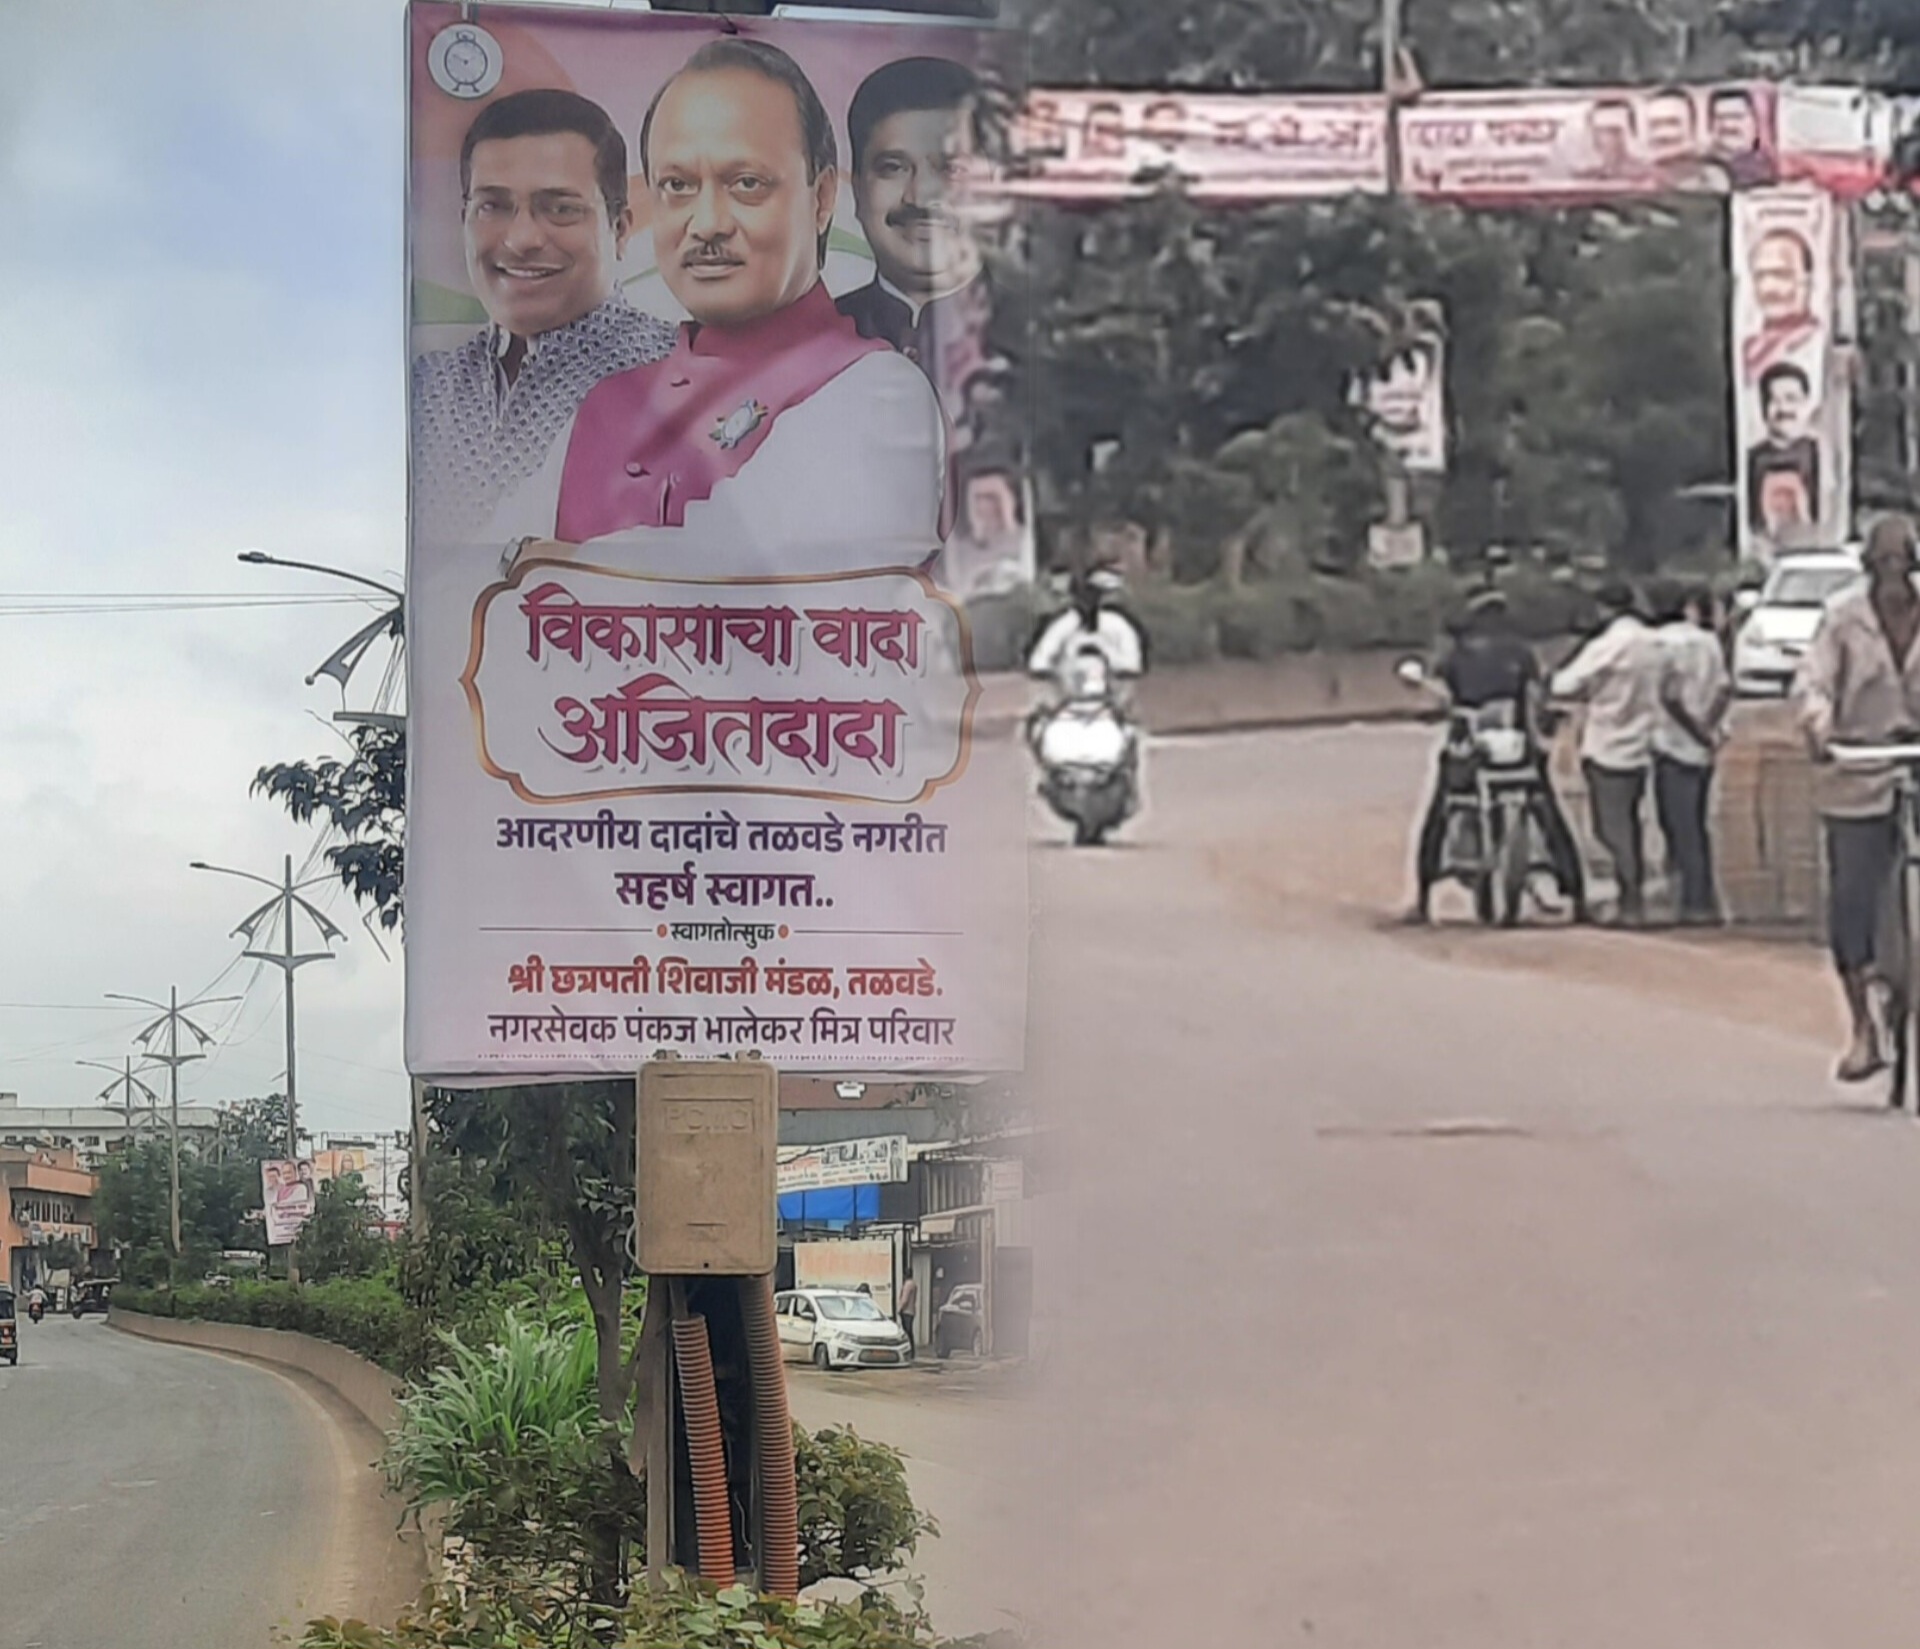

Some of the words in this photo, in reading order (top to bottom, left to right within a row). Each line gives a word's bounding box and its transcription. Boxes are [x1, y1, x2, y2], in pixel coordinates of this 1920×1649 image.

[519, 582, 799, 674] विकासाचा
[804, 607, 926, 676] वादा
[537, 673, 908, 775] अजितदादा
[497, 809, 642, 852] आदरणीय
[648, 810, 740, 853] दादांचे
[746, 811, 845, 853] तळवडे
[851, 812, 948, 853] नगरीत
[614, 861, 697, 910] सहर्ष
[704, 872, 834, 907] स्वागत..
[670, 917, 776, 949] स्वागतोत्सुक
[508, 954, 545, 994] श्री
[549, 955, 651, 995] छत्रपती
[656, 956, 758, 995] शिवाजी
[764, 957, 840, 1000] मंडळ,
[846, 957, 943, 997] तळवडे.
[487, 1004, 618, 1043] नगरसेवक
[624, 1006, 698, 1044] पंकज
[704, 1006, 804, 1044] भालेकर
[810, 1006, 862, 1045] मित्र
[868, 1007, 956, 1046] परिवार
